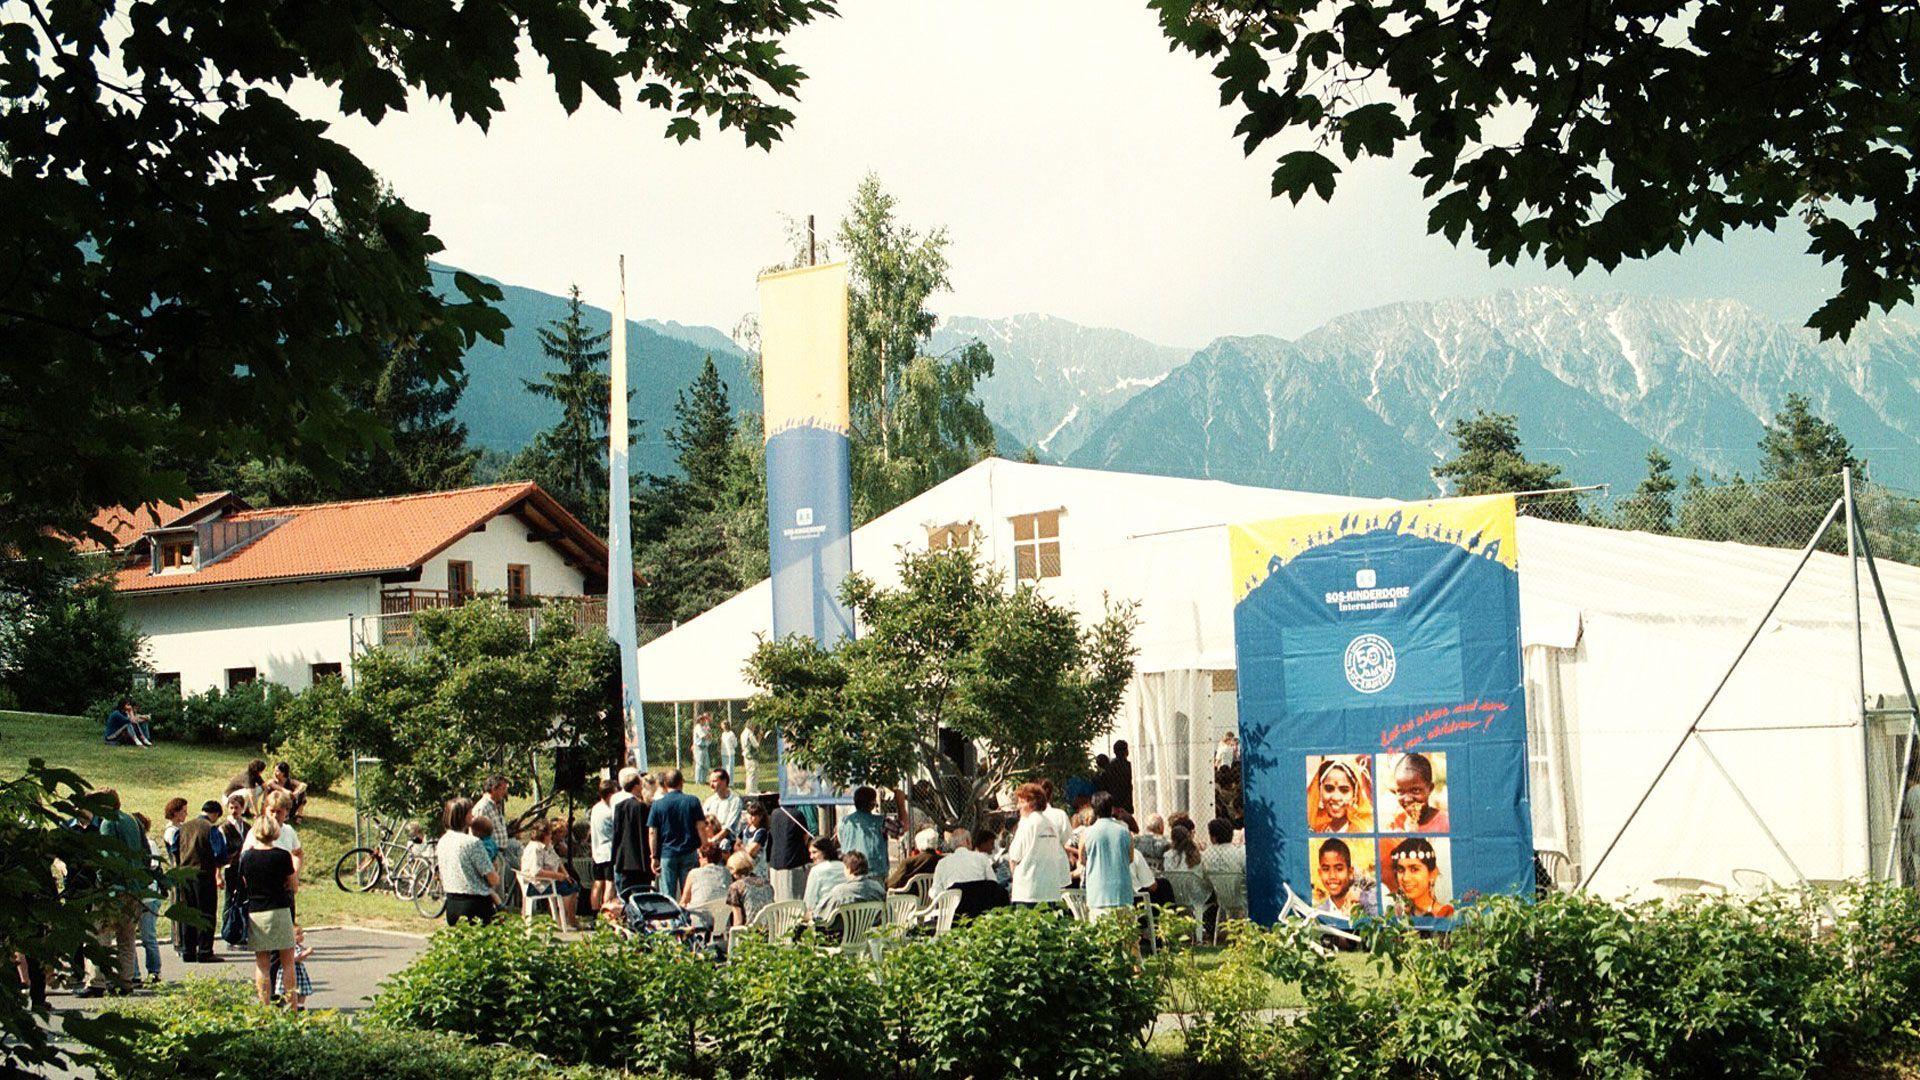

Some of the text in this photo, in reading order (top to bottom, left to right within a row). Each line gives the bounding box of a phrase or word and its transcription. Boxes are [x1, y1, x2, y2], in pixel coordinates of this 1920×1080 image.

[1325, 586, 1410, 603] SOS-KINDERDORF
[1339, 598, 1397, 612] International
[1356, 646, 1381, 669] 50
